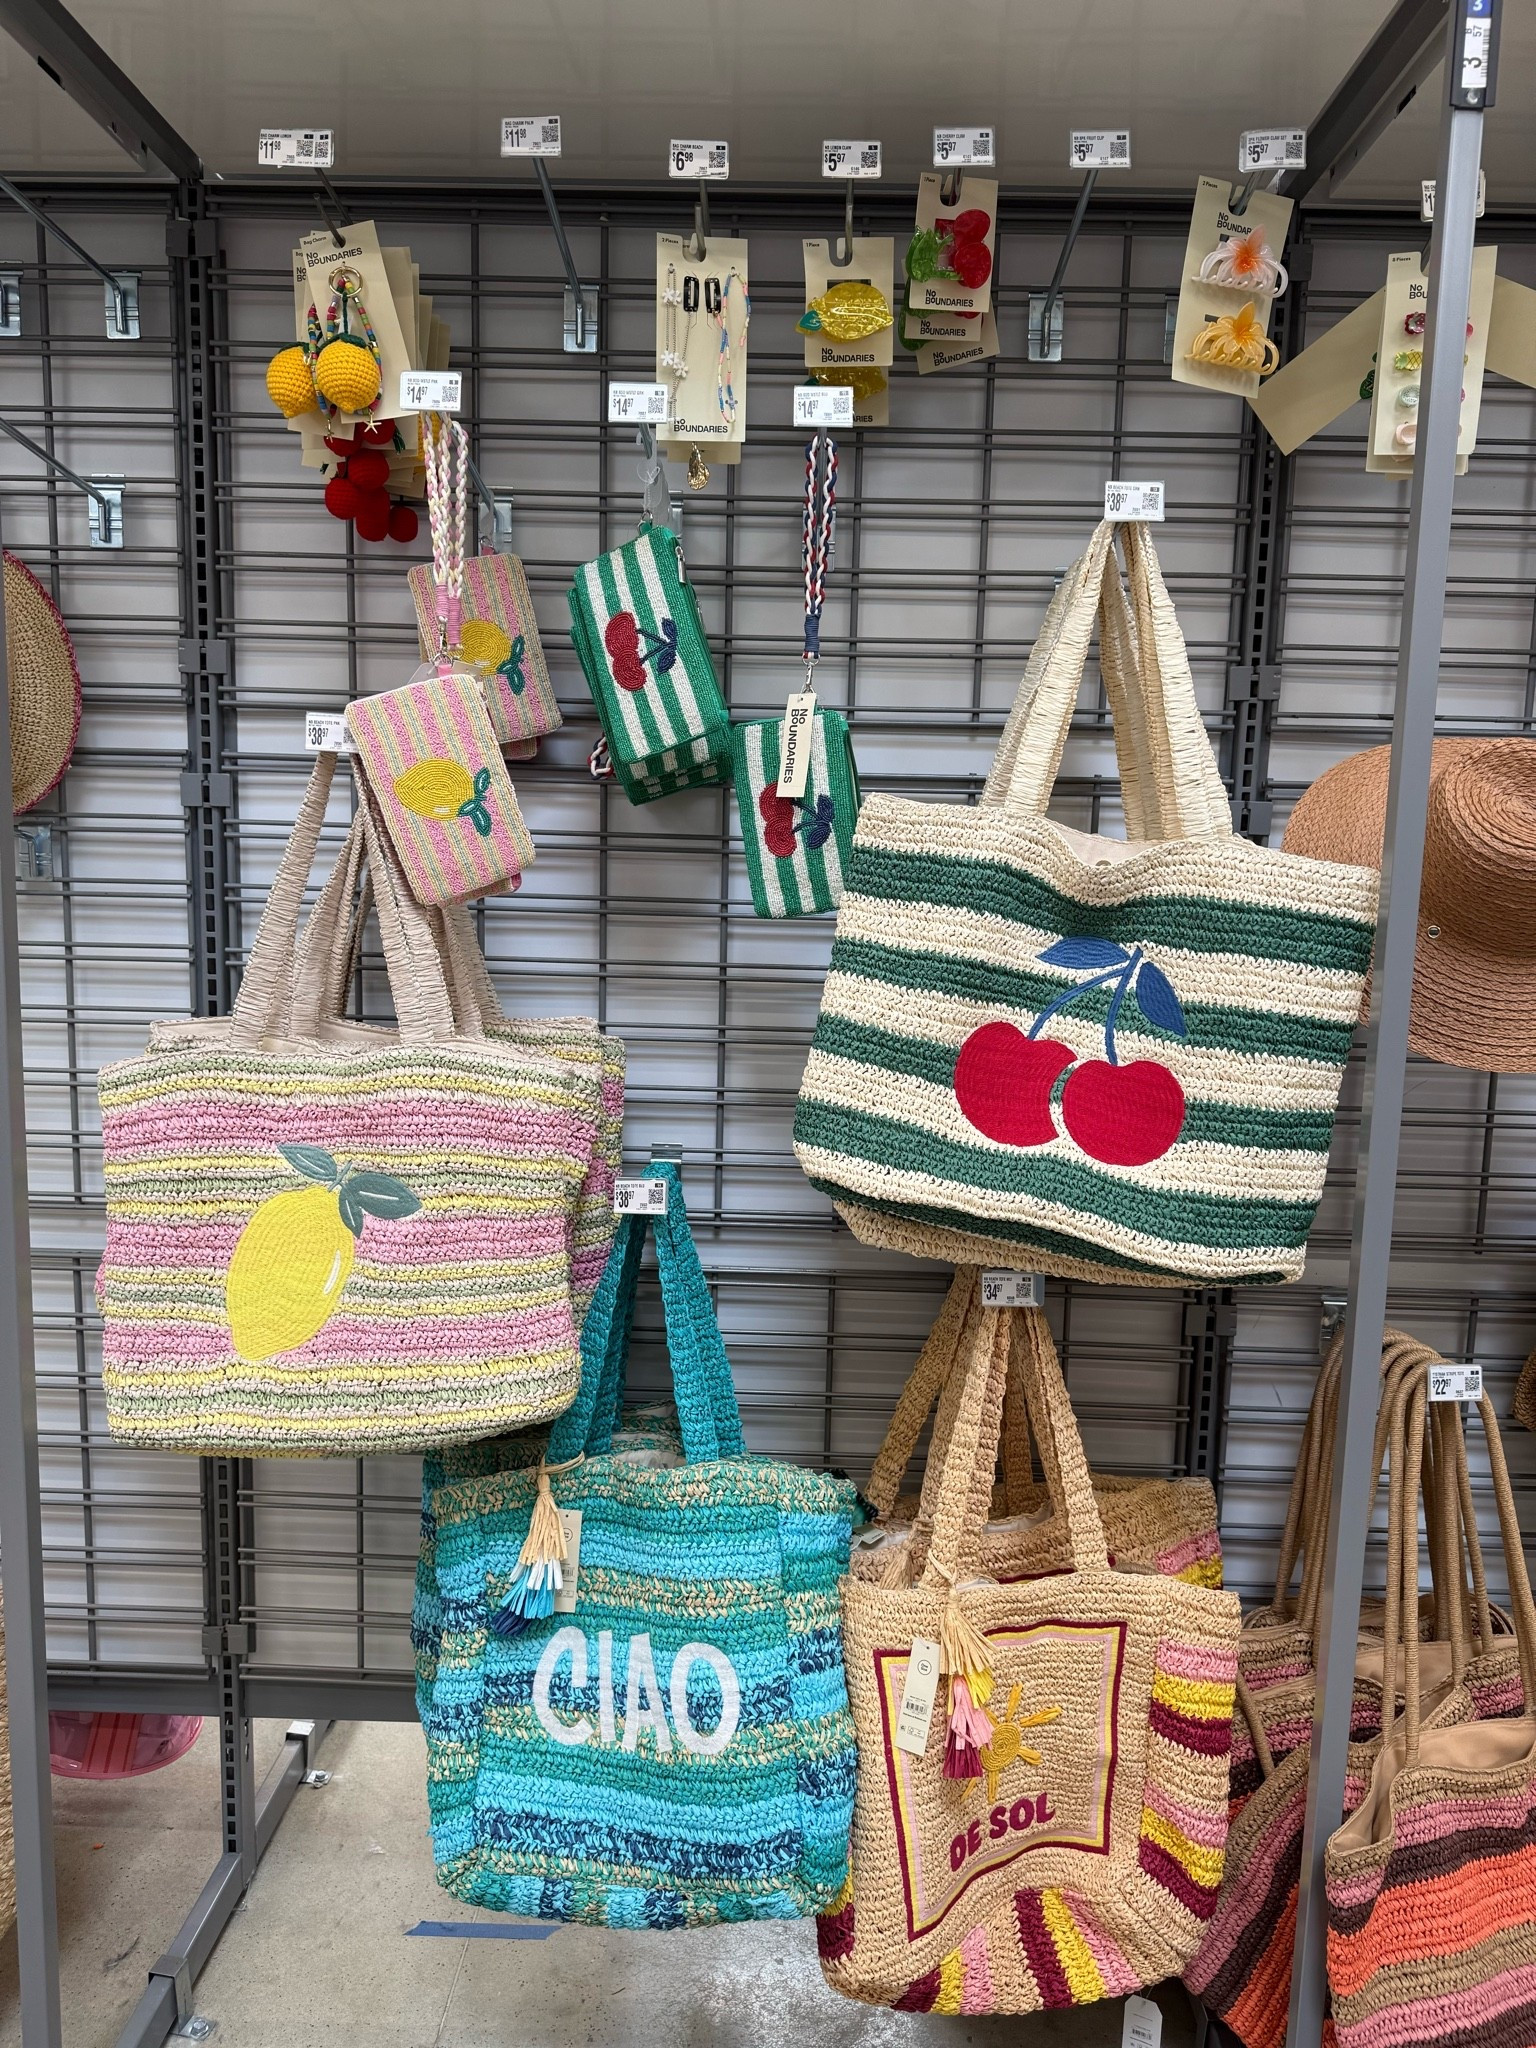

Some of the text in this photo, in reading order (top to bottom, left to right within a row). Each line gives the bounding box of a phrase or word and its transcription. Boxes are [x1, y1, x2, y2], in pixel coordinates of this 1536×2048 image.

[532, 1626, 740, 1756] CIAO
[950, 1792, 1056, 1872] DE SOL
